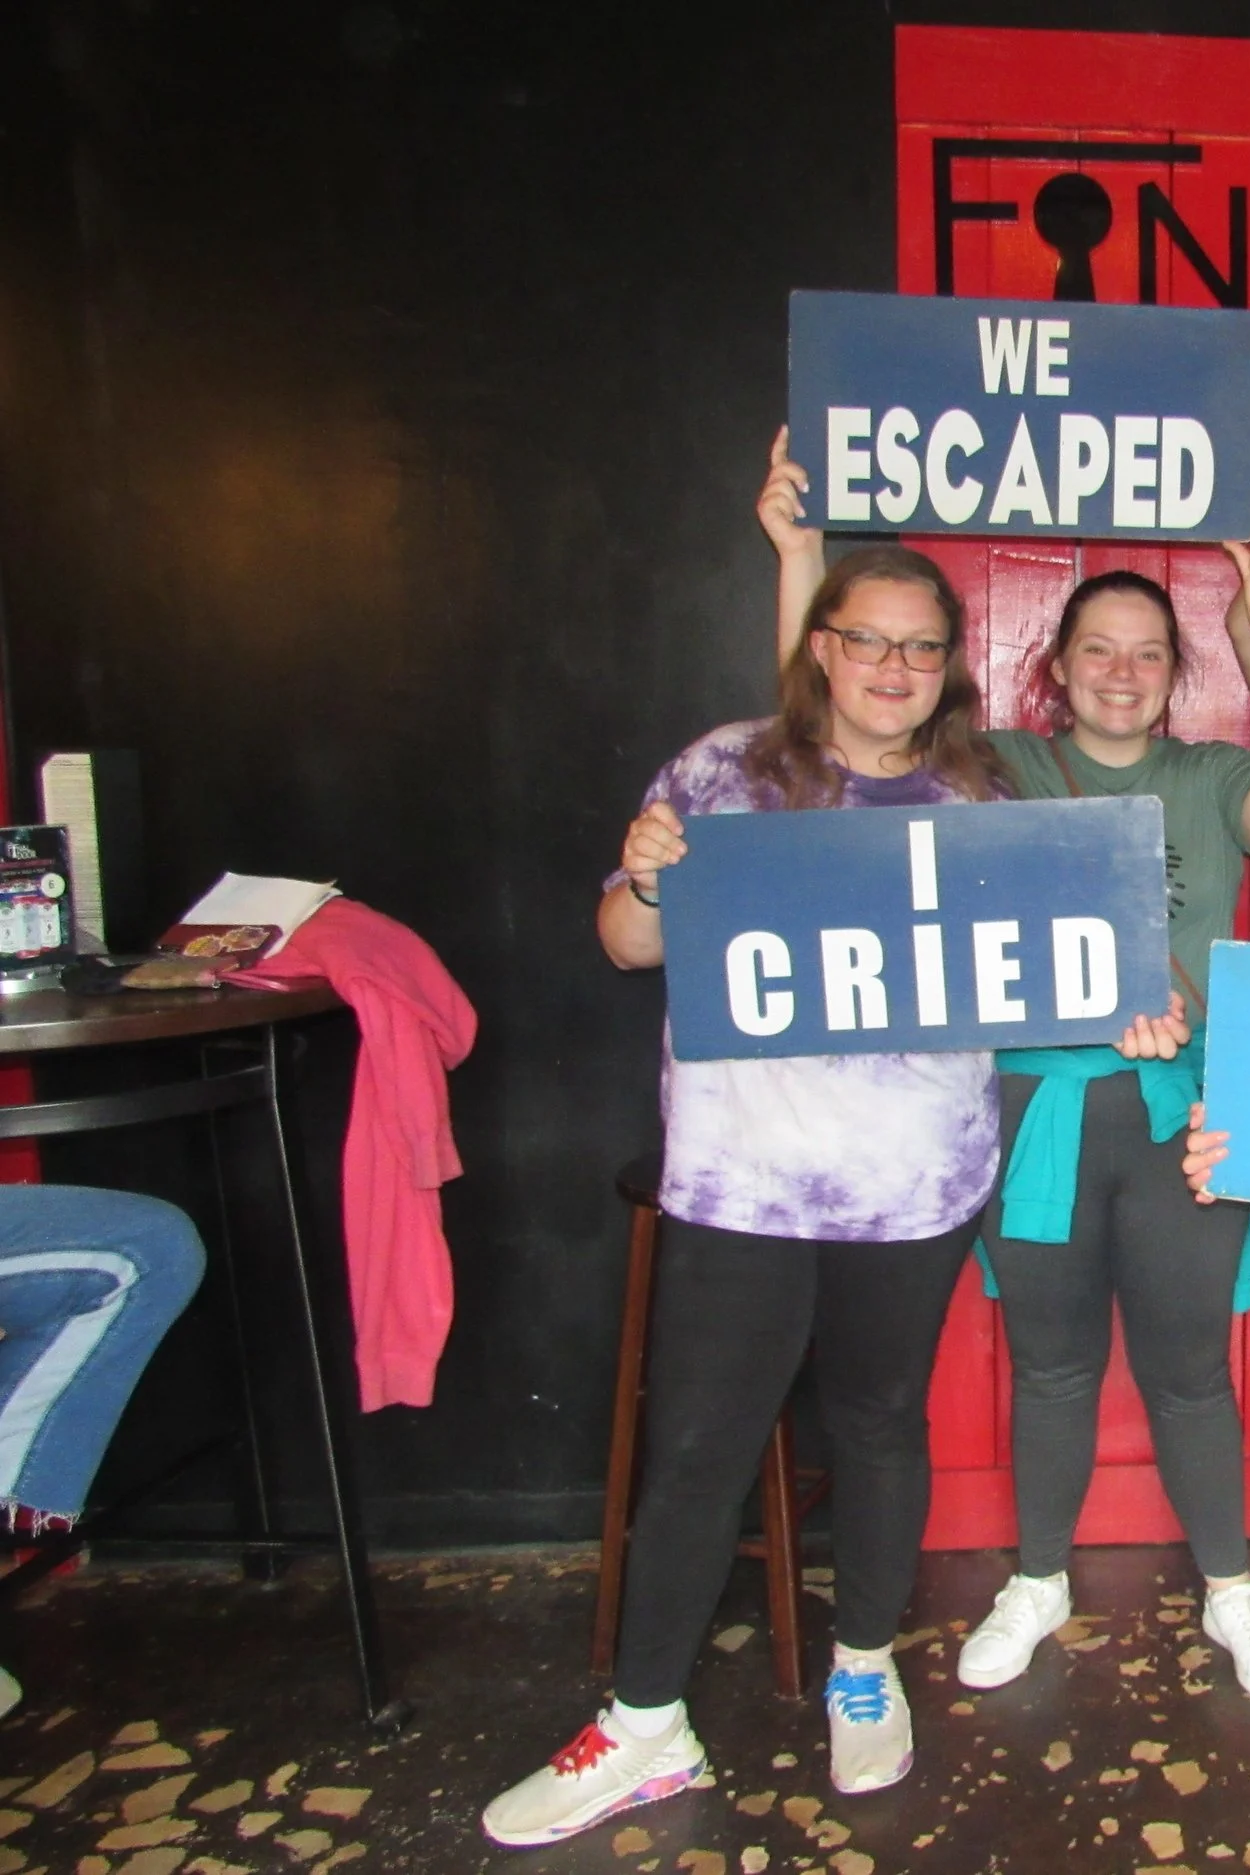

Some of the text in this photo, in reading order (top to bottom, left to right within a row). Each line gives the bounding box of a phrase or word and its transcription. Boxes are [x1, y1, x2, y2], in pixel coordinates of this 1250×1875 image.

[978, 317, 1070, 396] WE
[827, 407, 1215, 529] ESCAPED
[908, 819, 939, 911] I
[725, 916, 1119, 1037] CRIED
